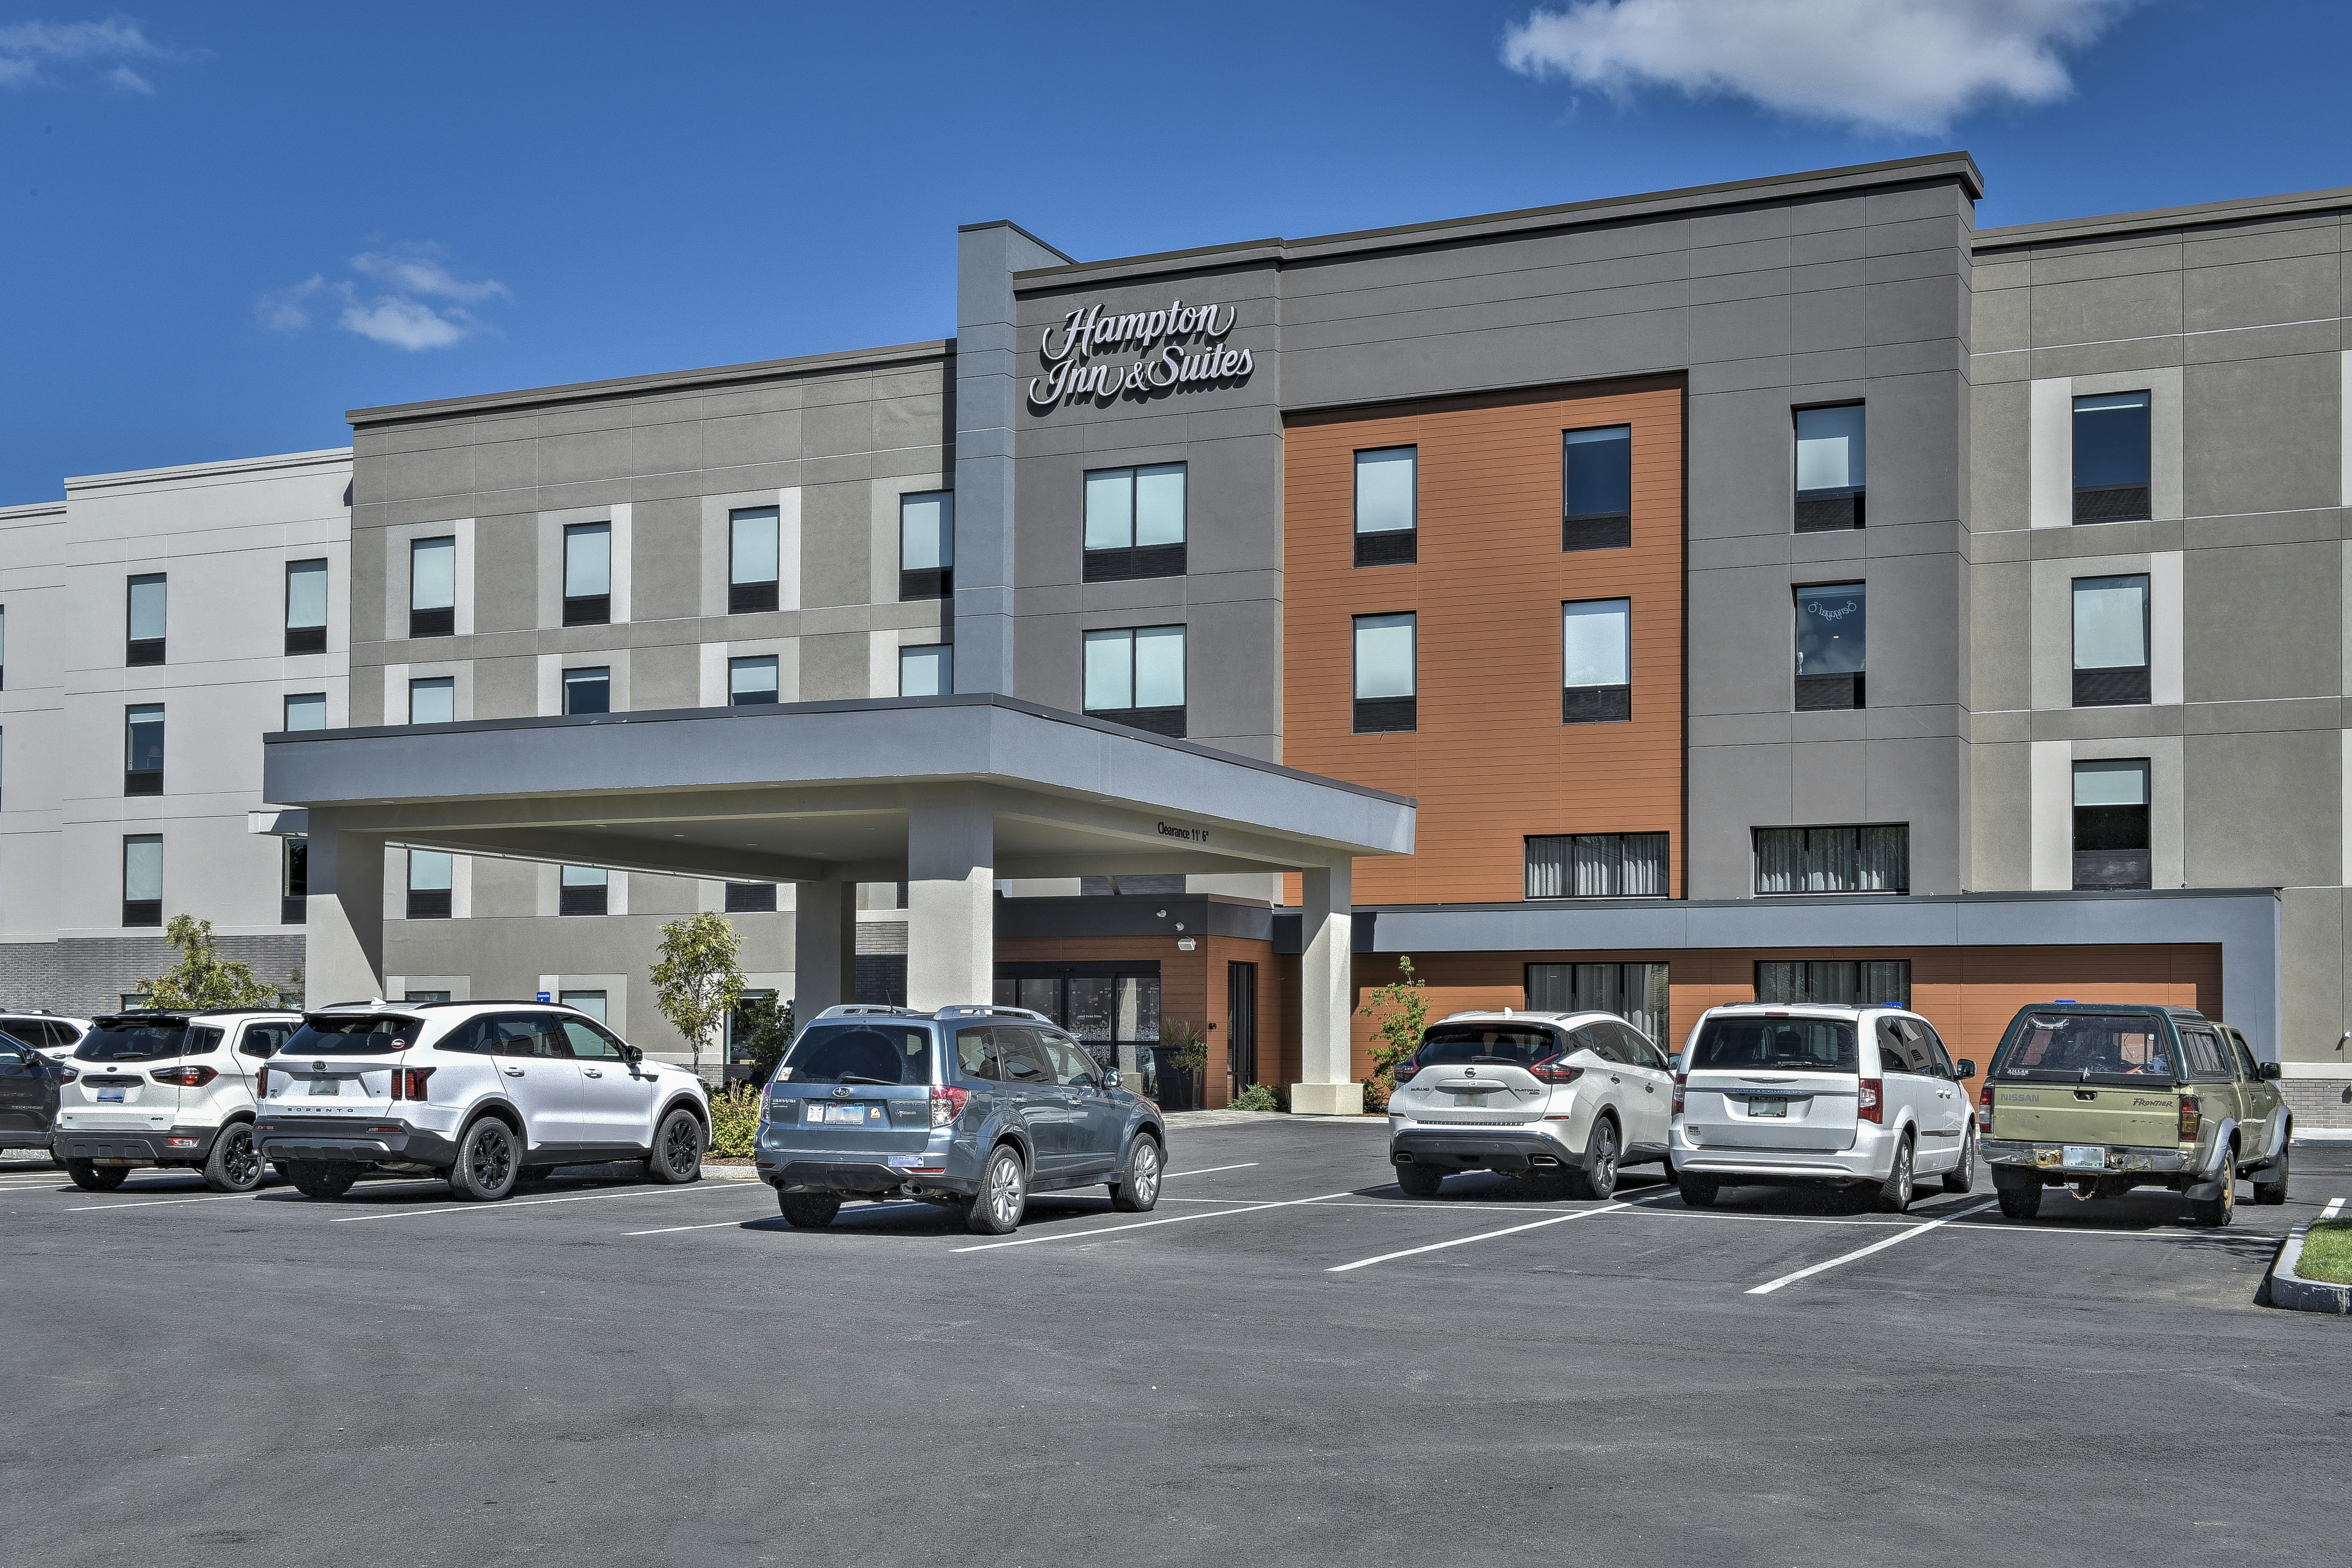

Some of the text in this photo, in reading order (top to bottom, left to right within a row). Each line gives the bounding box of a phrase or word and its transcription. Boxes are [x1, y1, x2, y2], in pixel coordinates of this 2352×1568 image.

[1043, 299, 1235, 360] Hampton
[1029, 343, 1254, 405] Inn & Suites
[1158, 821, 1190, 839] Clearance
[2001, 1093, 2040, 1102] NISSAN
